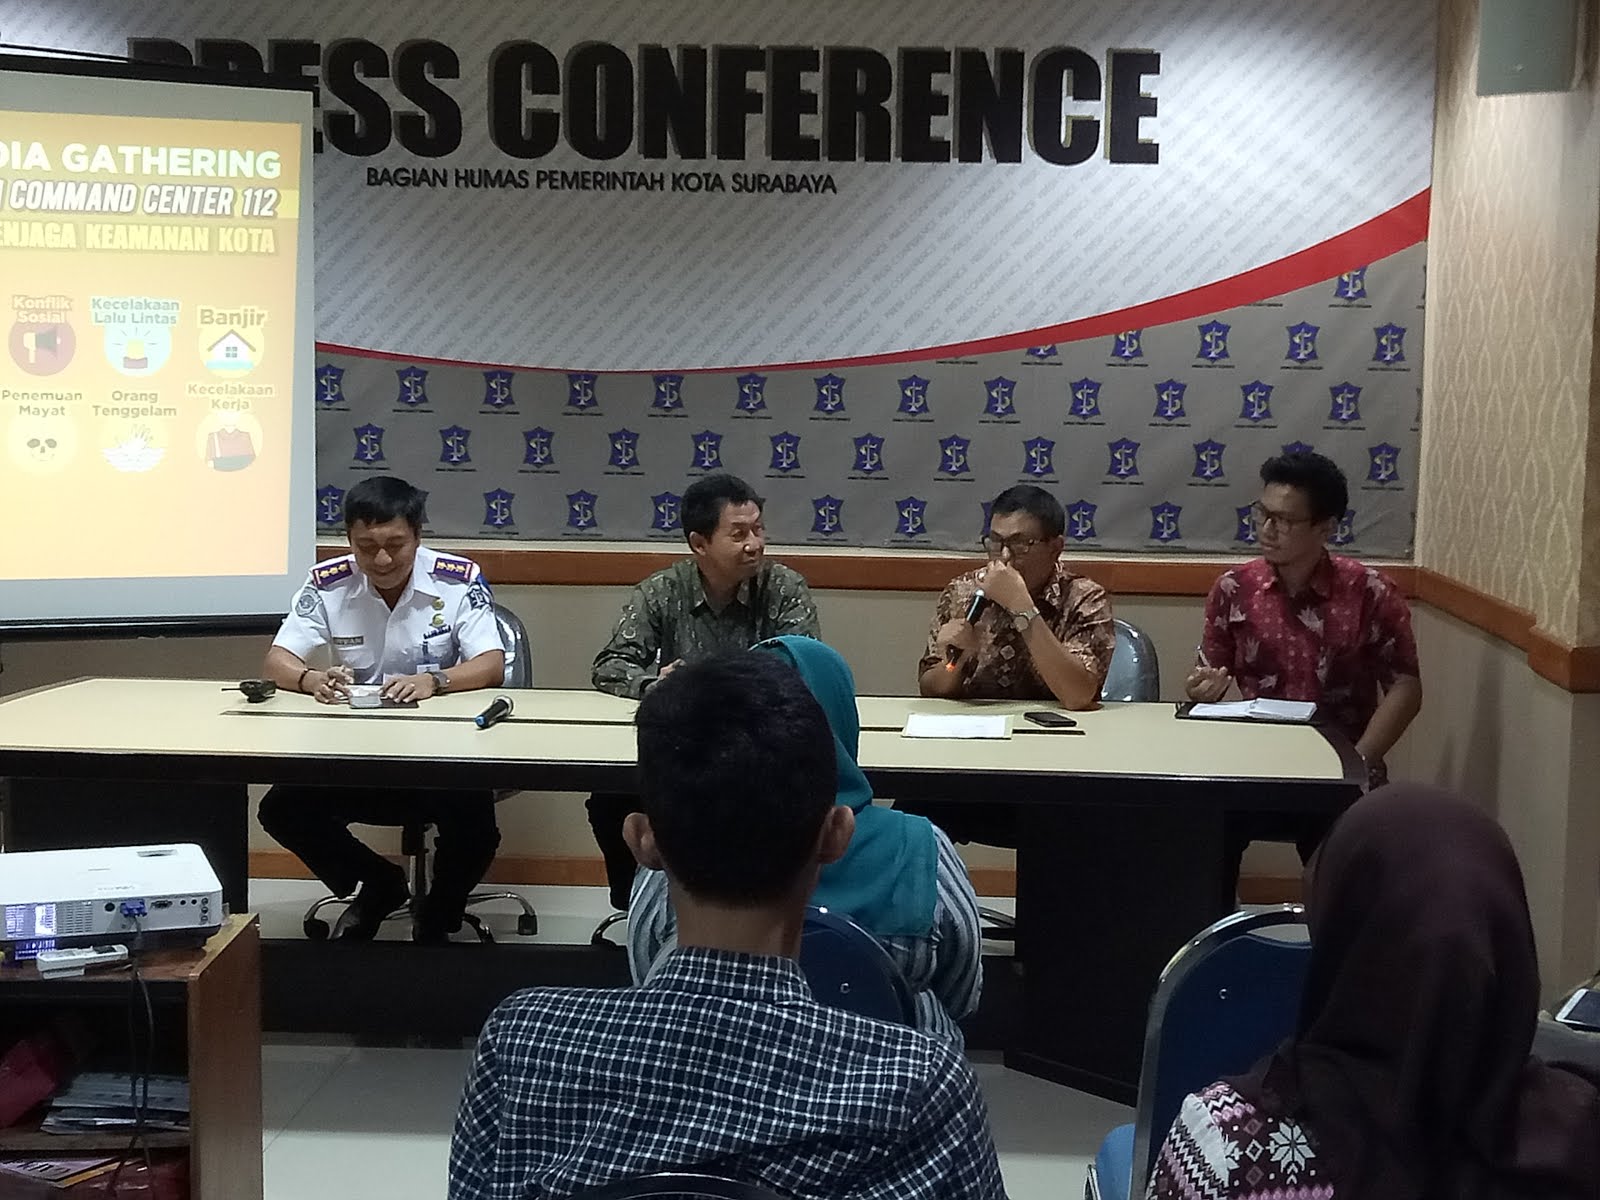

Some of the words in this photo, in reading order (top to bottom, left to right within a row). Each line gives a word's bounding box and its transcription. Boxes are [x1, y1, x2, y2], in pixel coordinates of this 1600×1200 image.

[488, 39, 1161, 165] CONFERENCE
[61, 143, 281, 179] GATHERING
[366, 167, 447, 189] BAGIAN
[455, 168, 529, 190] HUMAS
[536, 170, 664, 191] PEMERINTAH
[671, 172, 725, 193] KOTA
[731, 173, 837, 195] SURABAYA
[9, 179, 138, 213] COMMAND
[142, 184, 235, 216] CENTER
[241, 187, 279, 217] 112
[0, 220, 77, 249] NJAGA
[86, 223, 209, 251] KEAMANAN
[218, 227, 276, 252] KOTA
[12, 296, 72, 310] Konflik
[91, 298, 180, 311] Kecelakaan
[17, 310, 65, 323] Sosial
[94, 312, 127, 324] Lalu
[131, 313, 177, 325] Lintas
[200, 308, 266, 328] Banjir
[1, 389, 83, 401] Penemuan
[111, 390, 159, 403] Orang
[187, 384, 274, 396] Kecelakaan
[19, 405, 66, 418] Mayat
[92, 405, 177, 418] Tenggelam
[211, 399, 250, 411] Kerja
